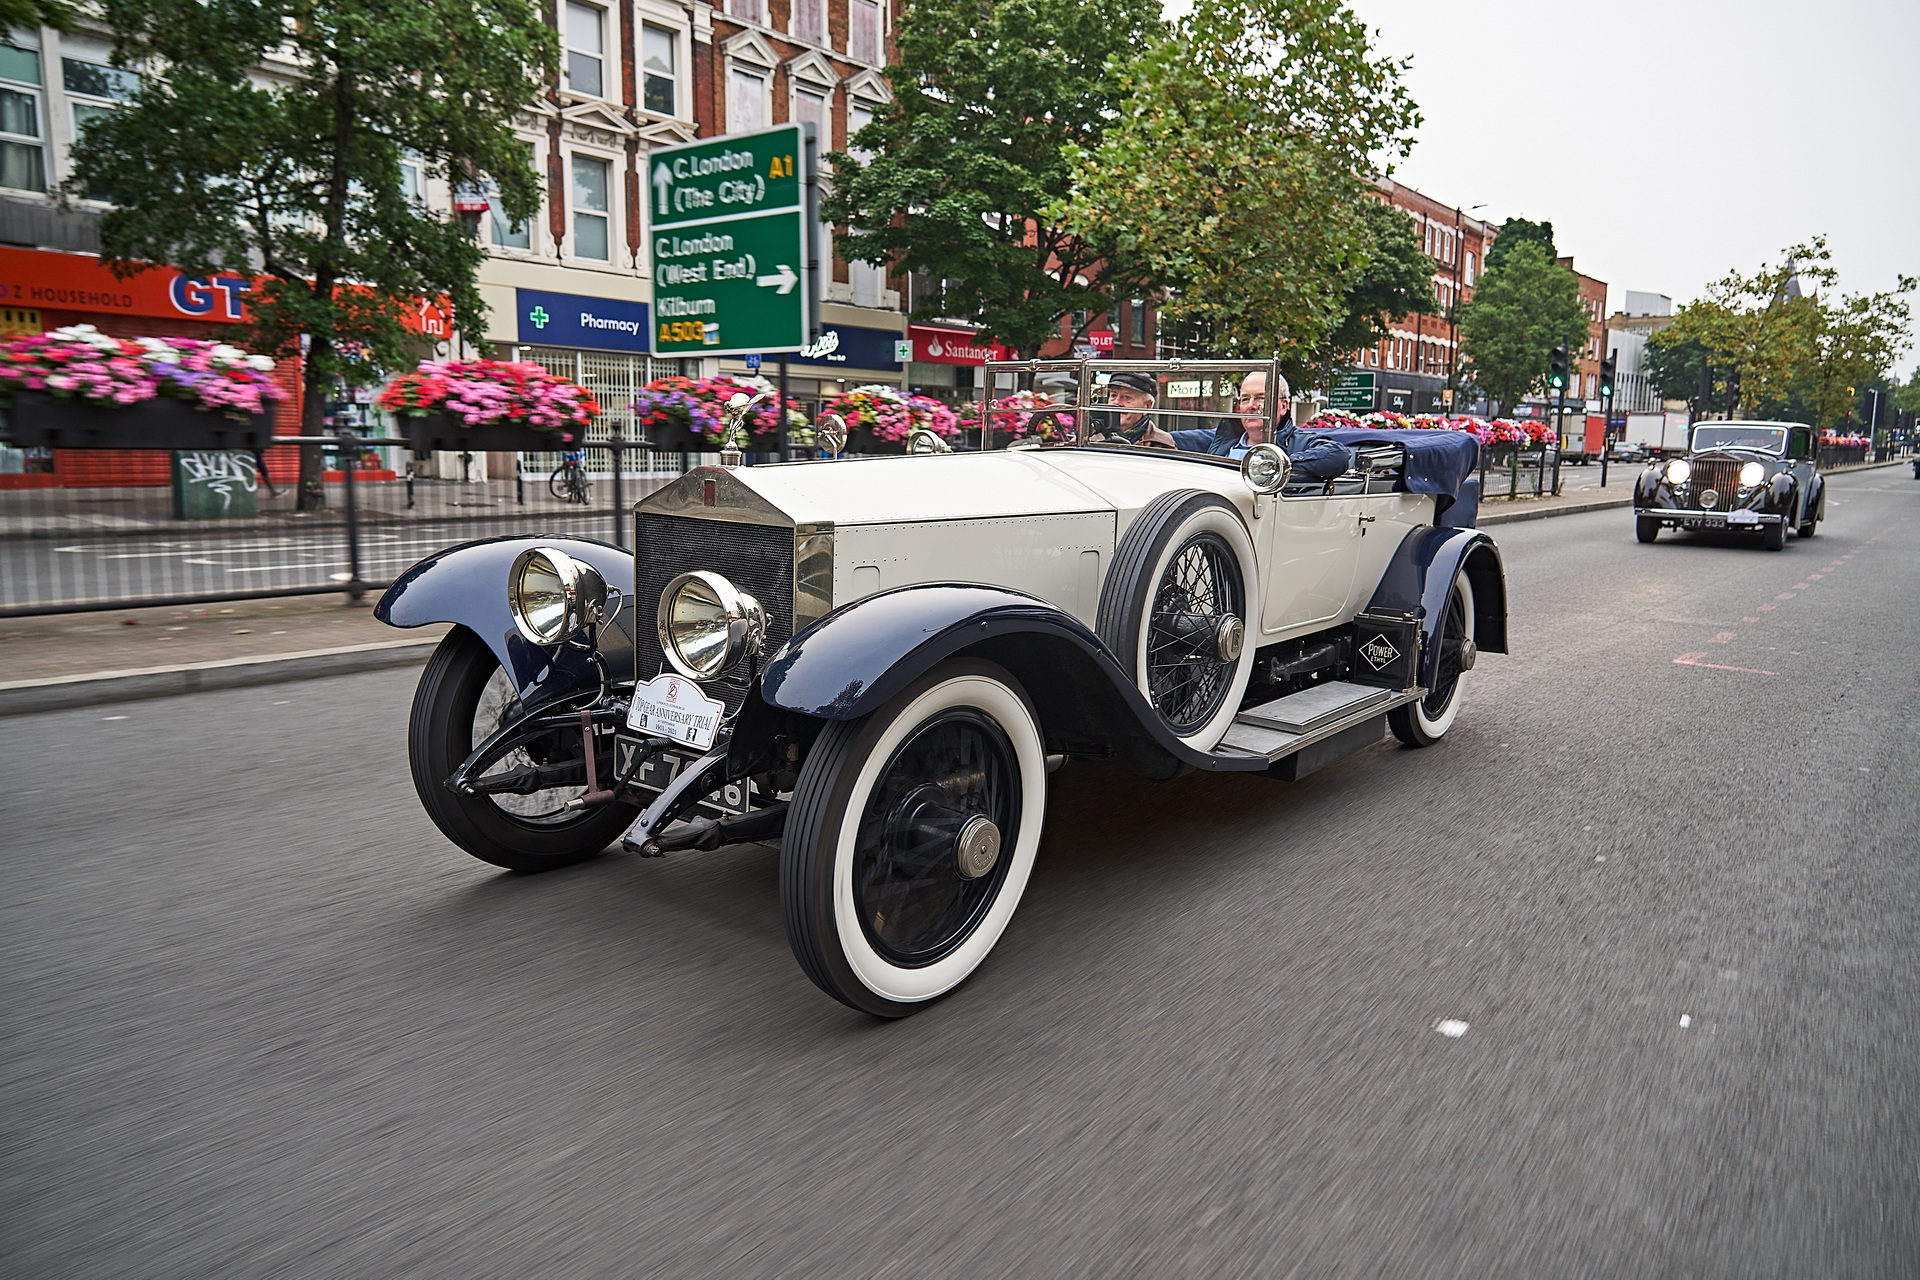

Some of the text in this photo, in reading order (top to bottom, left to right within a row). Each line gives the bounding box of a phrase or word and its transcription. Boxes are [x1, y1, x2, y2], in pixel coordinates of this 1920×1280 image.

[768, 154, 793, 179] A1
[674, 173, 766, 213] (The City)
[656, 253, 756, 287] (West End)
[30, 287, 133, 308] HOUSEHOLD
[657, 296, 716, 317] Kilburn
[580, 312, 640, 336] Pharmacy
[1090, 336, 1113, 346] TO LET
[1683, 518, 1702, 527] EYY
[1368, 643, 1393, 658] POWER
[643, 701, 656, 717] GEAR
[655, 705, 694, 726] ANNIVERSARY
[694, 714, 713, 731] TRIAL
